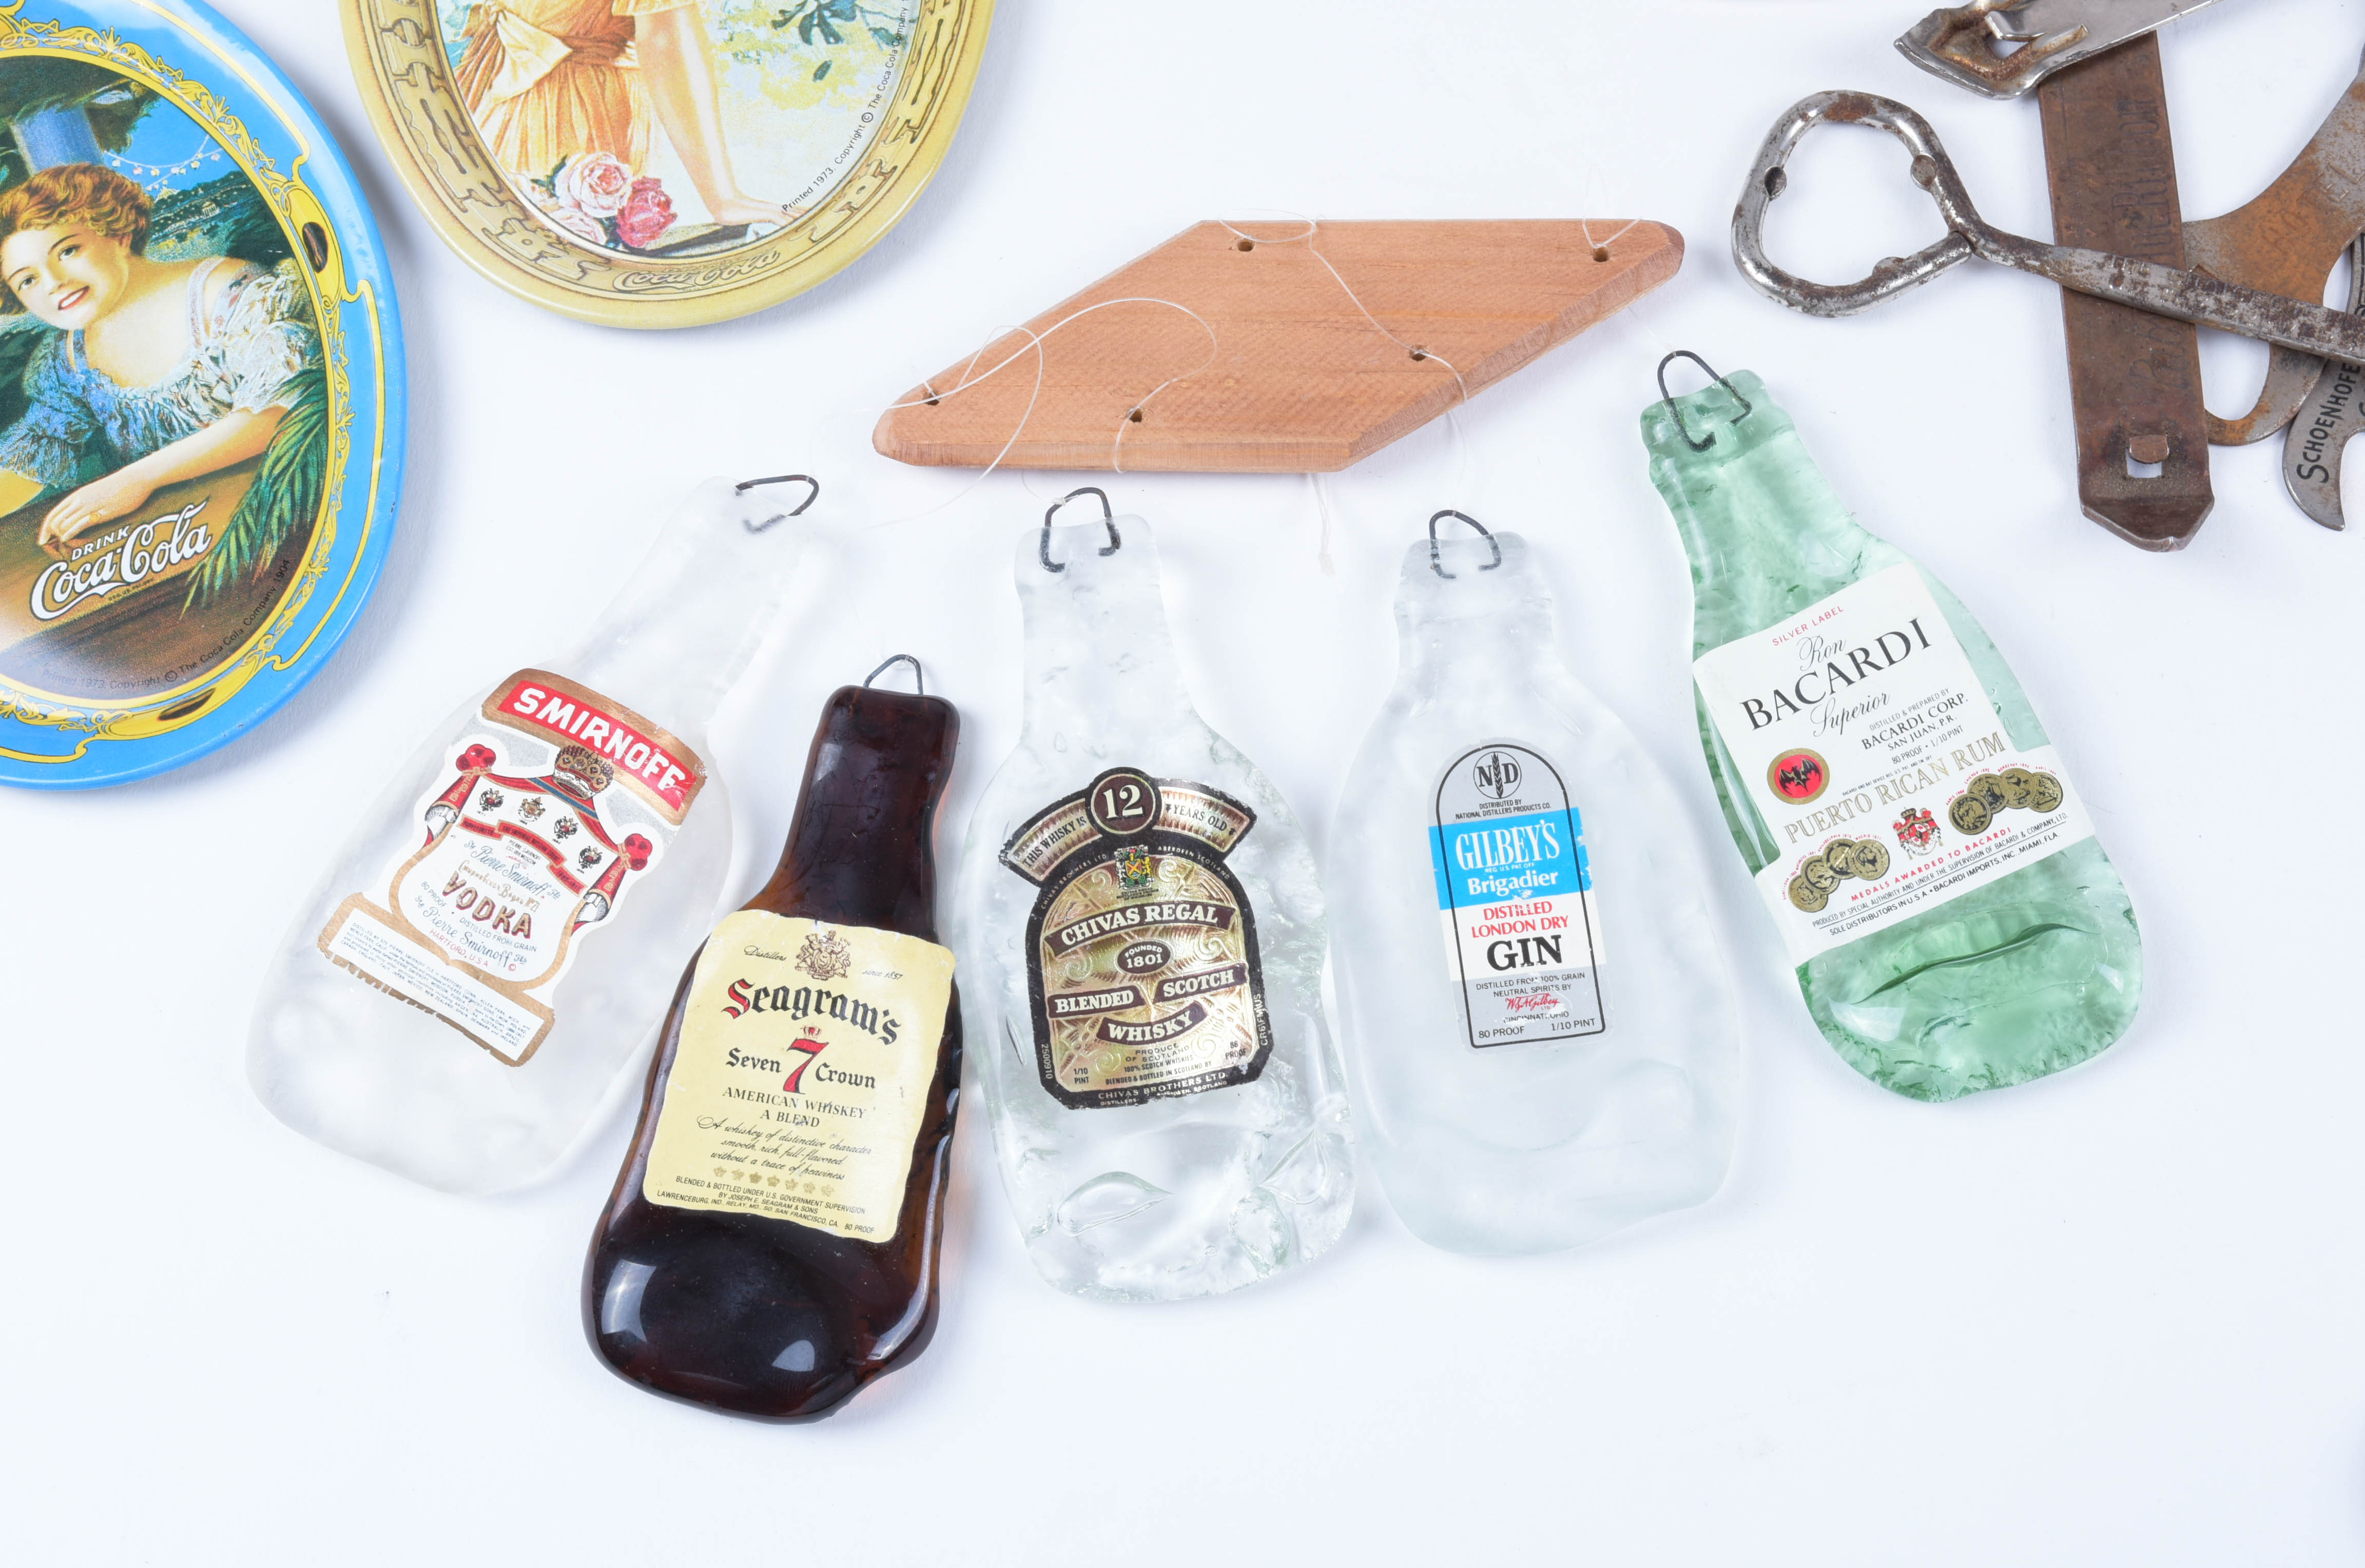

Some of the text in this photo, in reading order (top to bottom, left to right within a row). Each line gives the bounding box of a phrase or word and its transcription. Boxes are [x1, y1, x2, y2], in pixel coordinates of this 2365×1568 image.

[782, 187, 813, 211] Printed
[835, 125, 866, 164] Copyright
[868, 94, 882, 110] The
[891, 7, 909, 47] Company
[30, 501, 212, 621] Coca-Cola
[71, 525, 130, 561] DRINK
[109, 676, 161, 690] Copyright
[179, 662, 198, 674] The
[223, 628, 245, 645] Cola
[243, 585, 278, 626] Company
[1772, 605, 1844, 646] SILVER LABEL
[1796, 634, 1847, 671] Ron
[1739, 617, 1932, 731] BACARDI
[1810, 692, 1891, 737] Superior
[1862, 693, 1968, 750] BACARDI CORP.
[1869, 688, 1950, 731] DISTILLED PREPARED BY
[513, 688, 686, 791] SMIRNOFF
[1888, 714, 1957, 751] SAN JUAN, P.R.
[1891, 725, 1963, 764] 80 PROOF 1/10 PINT
[1102, 785, 1143, 819] 12
[1479, 799, 1514, 810] DISTRIBUTED
[1784, 732, 2006, 844] PUERTO RICAN RUM
[1456, 812, 1481, 820] NATIONAL
[1483, 808, 1512, 816] DISTILLERS
[1514, 804, 1541, 813] PRODUCTS
[1022, 804, 1227, 867] THIS WHISKY IS YEARS OLD
[1456, 819, 1560, 870] GILBEY'S
[470, 846, 505, 872] Pierre
[502, 863, 552, 896] Smirnoff
[1041, 846, 1230, 909] CHIVAS BROTHERS ABERDEEN SCOTLAND
[1812, 914, 1838, 927] PRODUCED
[1848, 904, 1870, 915] SPECIAL
[1871, 890, 1900, 906] AUTHORITY
[1902, 883, 1914, 892] AND
[1916, 873, 1934, 886] UNDER
[1936, 866, 1946, 876] THE
[1948, 850, 1985, 870] SUPERVISION
[1994, 834, 2019, 849] BACARDI
[2027, 818, 2057, 834] COMPANY,
[2056, 813, 2069, 822] LTD.
[1851, 827, 2011, 901] MEDALS AWARDED TO BACARDI
[1467, 870, 1558, 896] Brigadier
[1830, 926, 1846, 935] SOLE
[1847, 904, 1897, 930] DISTRIBUTORS
[1933, 874, 1966, 892] BACARDI
[1967, 858, 2002, 877] IMPORTS,
[421, 881, 537, 953] 80 PROOF DISTILLED FROM GRAIN
[442, 871, 532, 939] VODKA
[1484, 901, 1553, 920] DISTILLED
[422, 906, 513, 968] Pierre Smirnoff
[1061, 904, 1218, 945] CHIVAS REGAL
[1471, 915, 1568, 938] LONDON DRY
[429, 929, 468, 958] HARTFORD,
[744, 945, 786, 962] Distillers
[1125, 945, 1162, 957] FOUNDED
[1127, 954, 1162, 968] 1801
[1487, 934, 1562, 971] GIN
[884, 970, 903, 980] 1857
[1162, 969, 1235, 997] SCOTCH
[1476, 972, 1585, 990] DISTILLED GRAIN
[1494, 988, 1528, 997] NEUTRAL
[721, 978, 901, 1046] Seagram's
[1055, 990, 1134, 1013] BLENDED
[1108, 1010, 1193, 1041] WHISKY
[1479, 1018, 1596, 1038] 80 PROOF 1/10 PINT
[1041, 1044, 1052, 1079] 2500910
[1135, 1043, 1179, 1055] PRODUCE
[1141, 1054, 1193, 1070] SCOTCH WHISKIES
[1142, 1045, 1190, 1062] SCOTLAND
[1225, 1048, 1247, 1060] PROOF
[1230, 1041, 1238, 1049] 86
[725, 1037, 876, 1095] Seven 7 Crown
[1106, 1076, 1132, 1085] BLENDED
[1139, 1071, 1164, 1081] BOTTLED
[723, 1087, 866, 1119] AMERICAN WHISKEY
[1098, 1089, 1139, 1099] CHIVAS
[1143, 1076, 1201, 1094] BROTHERS
[1206, 1072, 1228, 1082] LTD.
[696, 1115, 872, 1155] A whiskey of distinctive character
[760, 1109, 820, 1127] A BLEND
[711, 1150, 749, 1163] without
[762, 1159, 786, 1170] trace
[789, 1164, 801, 1175] of
[802, 1164, 845, 1180] heaviness
[779, 1146, 847, 1165] full-flavored
[657, 1190, 710, 1204] LAWRENCEBURG,
[790, 1211, 827, 1225] FRANCISCO,
[855, 1225, 875, 1233] PROOF
[676, 1175, 866, 1214] BLENDED BOTTLED UNDER GOVERNMENT SUPERVISION
[728, 1194, 752, 1202] JOSEPH
[762, 1199, 793, 1209] SEAGRAM
